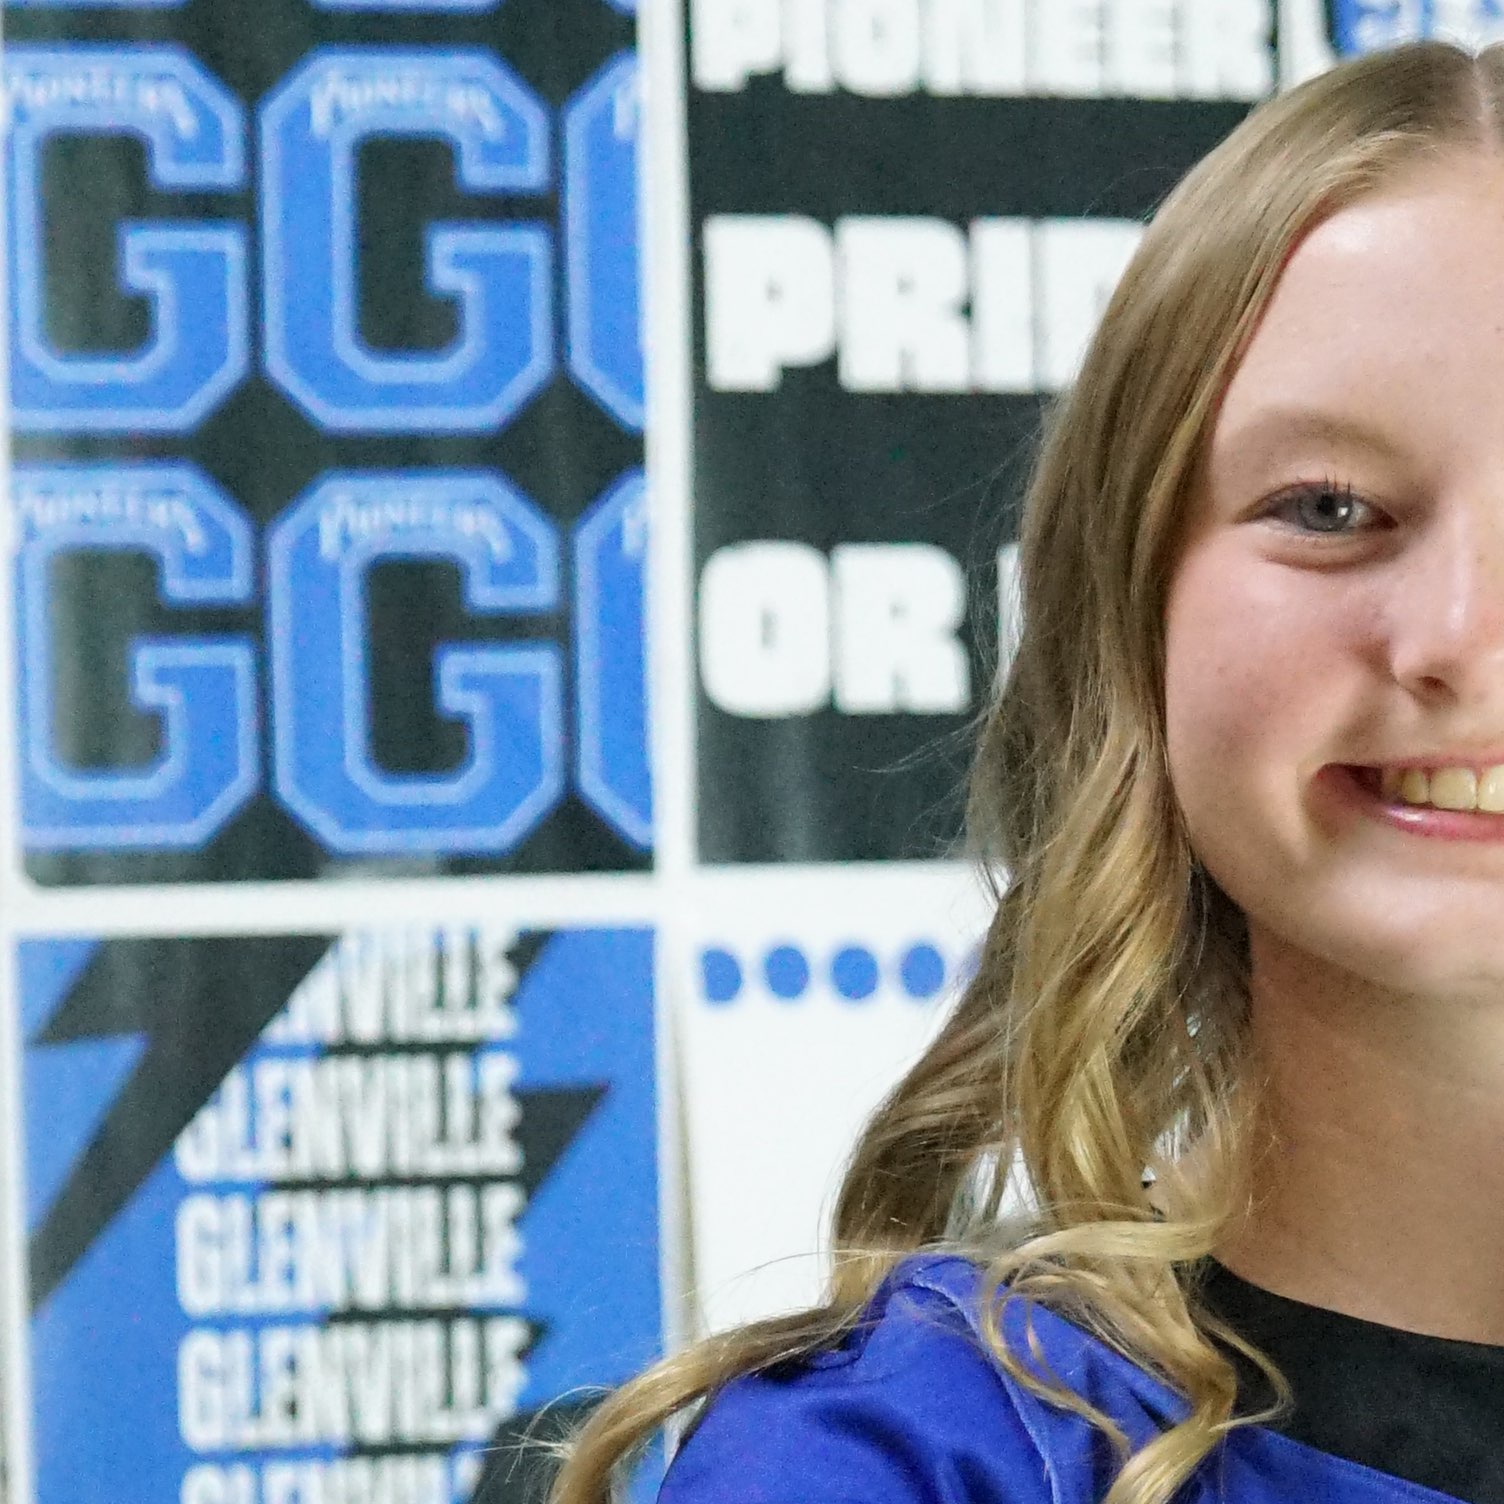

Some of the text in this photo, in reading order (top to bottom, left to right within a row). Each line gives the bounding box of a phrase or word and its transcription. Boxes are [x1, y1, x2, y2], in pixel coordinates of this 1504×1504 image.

[700, 538, 972, 717] OR
[174, 1184, 528, 1320] GLENVILLE
[178, 1316, 530, 1456] GLENVILLE
